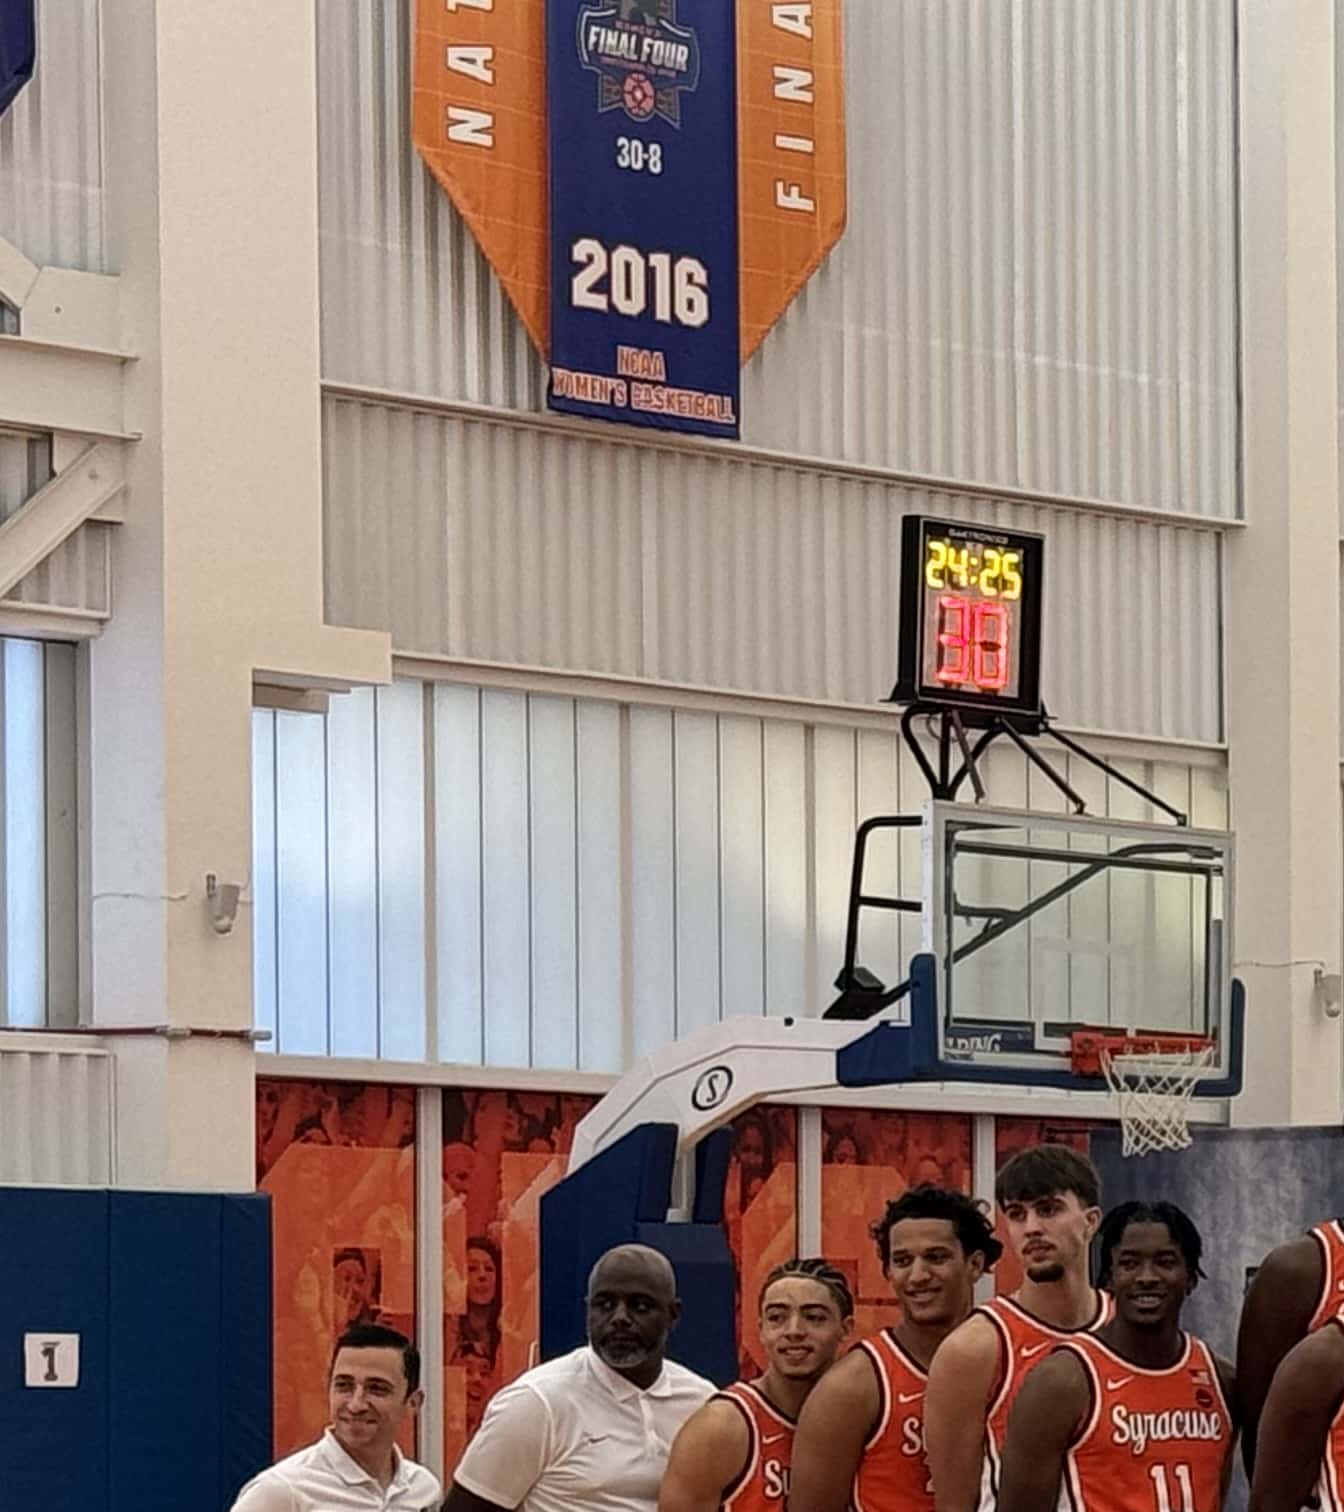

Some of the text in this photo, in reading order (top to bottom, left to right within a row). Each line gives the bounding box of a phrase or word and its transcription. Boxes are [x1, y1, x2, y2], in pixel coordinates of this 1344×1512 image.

[588, 24, 639, 61] FINAL
[640, 37, 689, 72] FOUR
[616, 136, 663, 175] 30-8
[570, 237, 711, 330] 2016
[616, 345, 667, 382] NCAA
[925, 538, 1022, 601] 24:25
[936, 595, 1009, 690] 30
[1112, 1405, 1222, 1455] Syracuse
